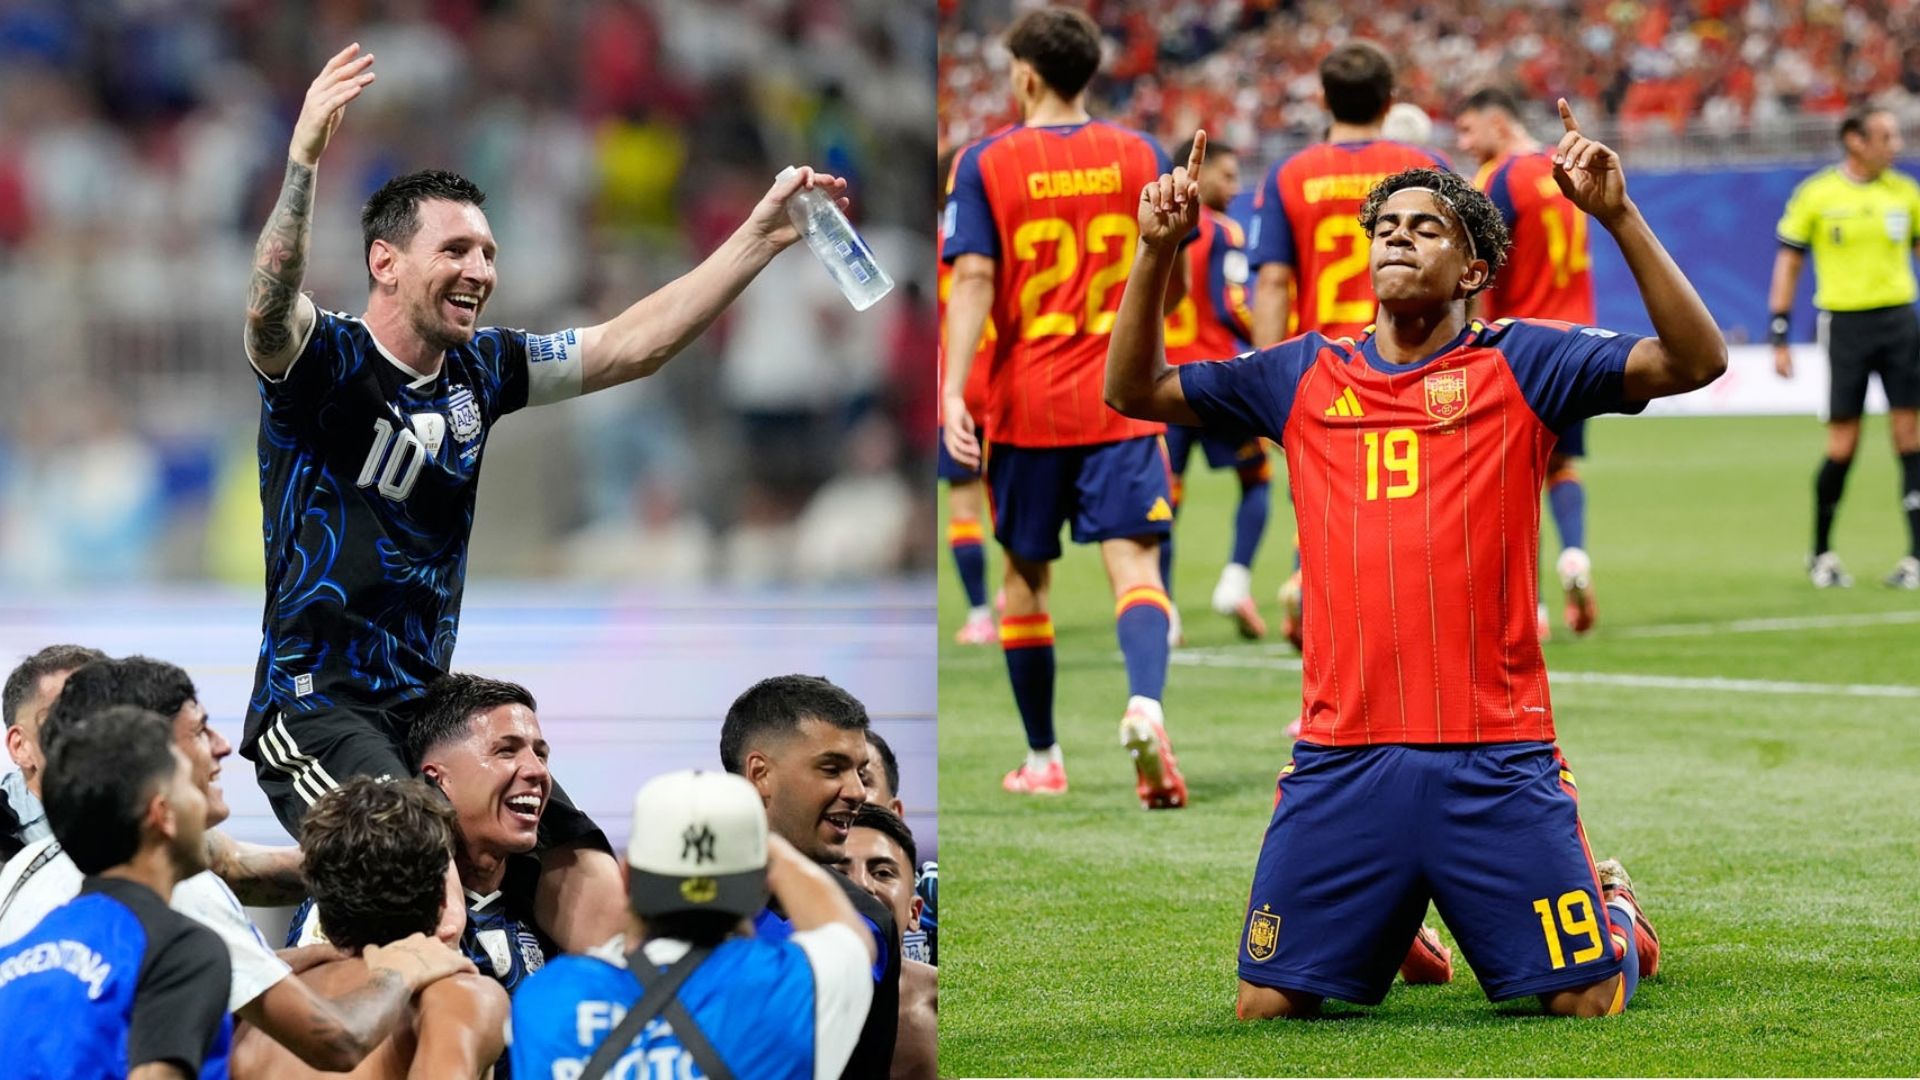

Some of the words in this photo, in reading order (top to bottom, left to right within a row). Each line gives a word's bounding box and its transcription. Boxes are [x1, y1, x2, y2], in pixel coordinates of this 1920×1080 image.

[1013, 213, 1139, 341] 22
[529, 334, 541, 362] FOOTB
[356, 417, 426, 502] 10
[1364, 428, 1419, 501] 19
[1532, 889, 1604, 970] 19
[0, 939, 112, 1000] RGENTINA
